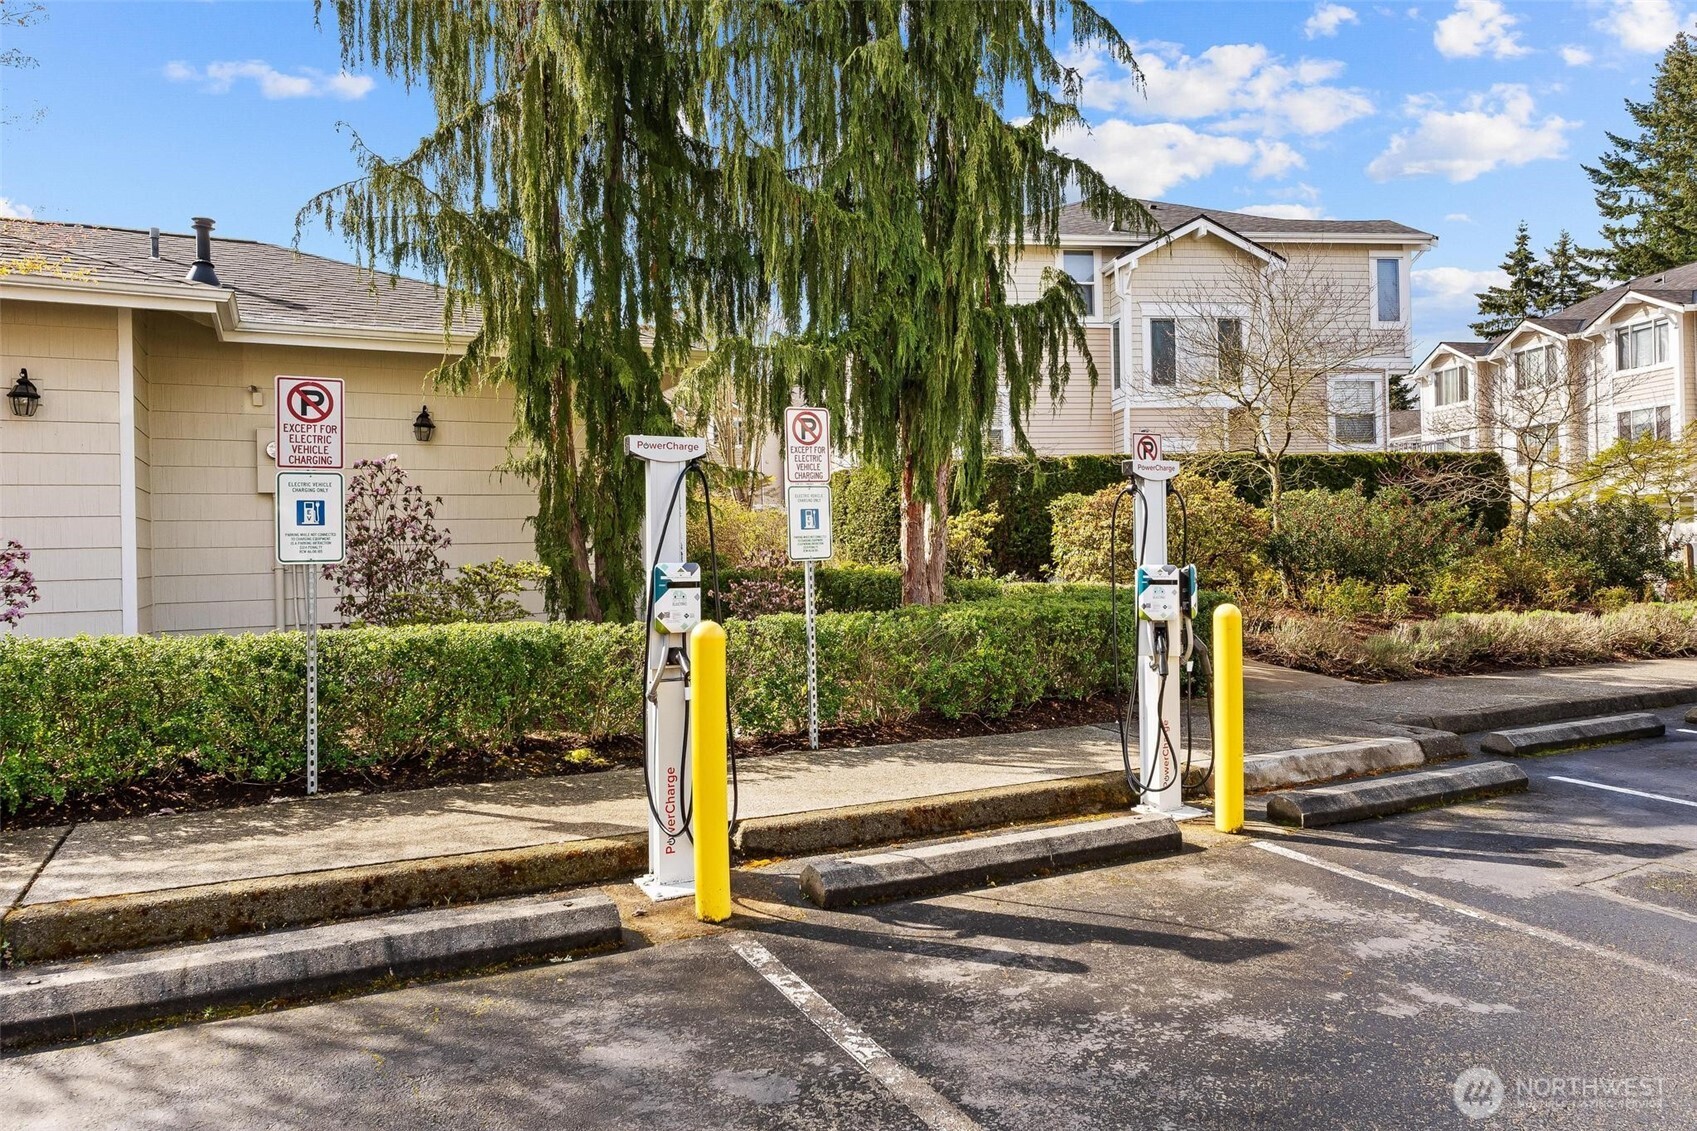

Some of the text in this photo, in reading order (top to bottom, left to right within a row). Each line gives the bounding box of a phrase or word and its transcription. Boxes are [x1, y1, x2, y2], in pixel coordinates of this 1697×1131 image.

[283, 424, 337, 434] EXCEPT FOR
[289, 434, 332, 444] ELECTRIC
[292, 445, 329, 454] VEHICLE
[637, 440, 699, 452] PowerCharge
[288, 455, 332, 465] CHARGING
[1138, 464, 1175, 472] PowerCharge
